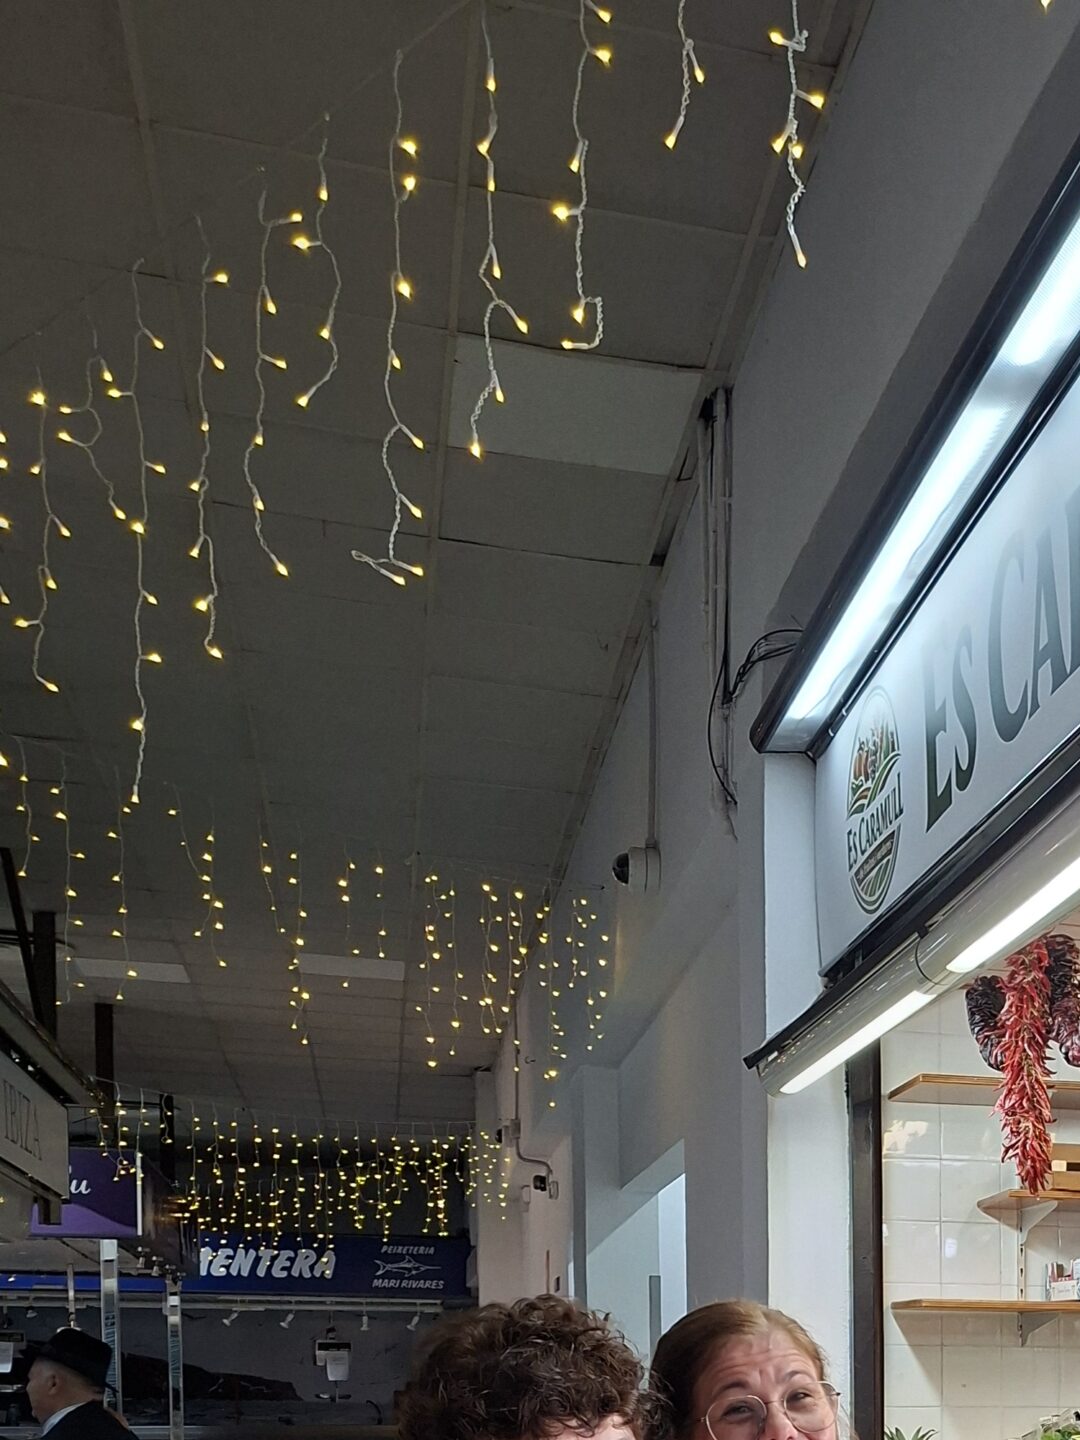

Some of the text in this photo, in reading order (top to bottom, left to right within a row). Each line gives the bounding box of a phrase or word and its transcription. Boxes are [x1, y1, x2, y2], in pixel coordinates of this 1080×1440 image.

[859, 772, 904, 856] CARAMULL
[381, 1244, 435, 1255] PEIXETERIA
[401, 1279, 444, 1289] RIVARES
